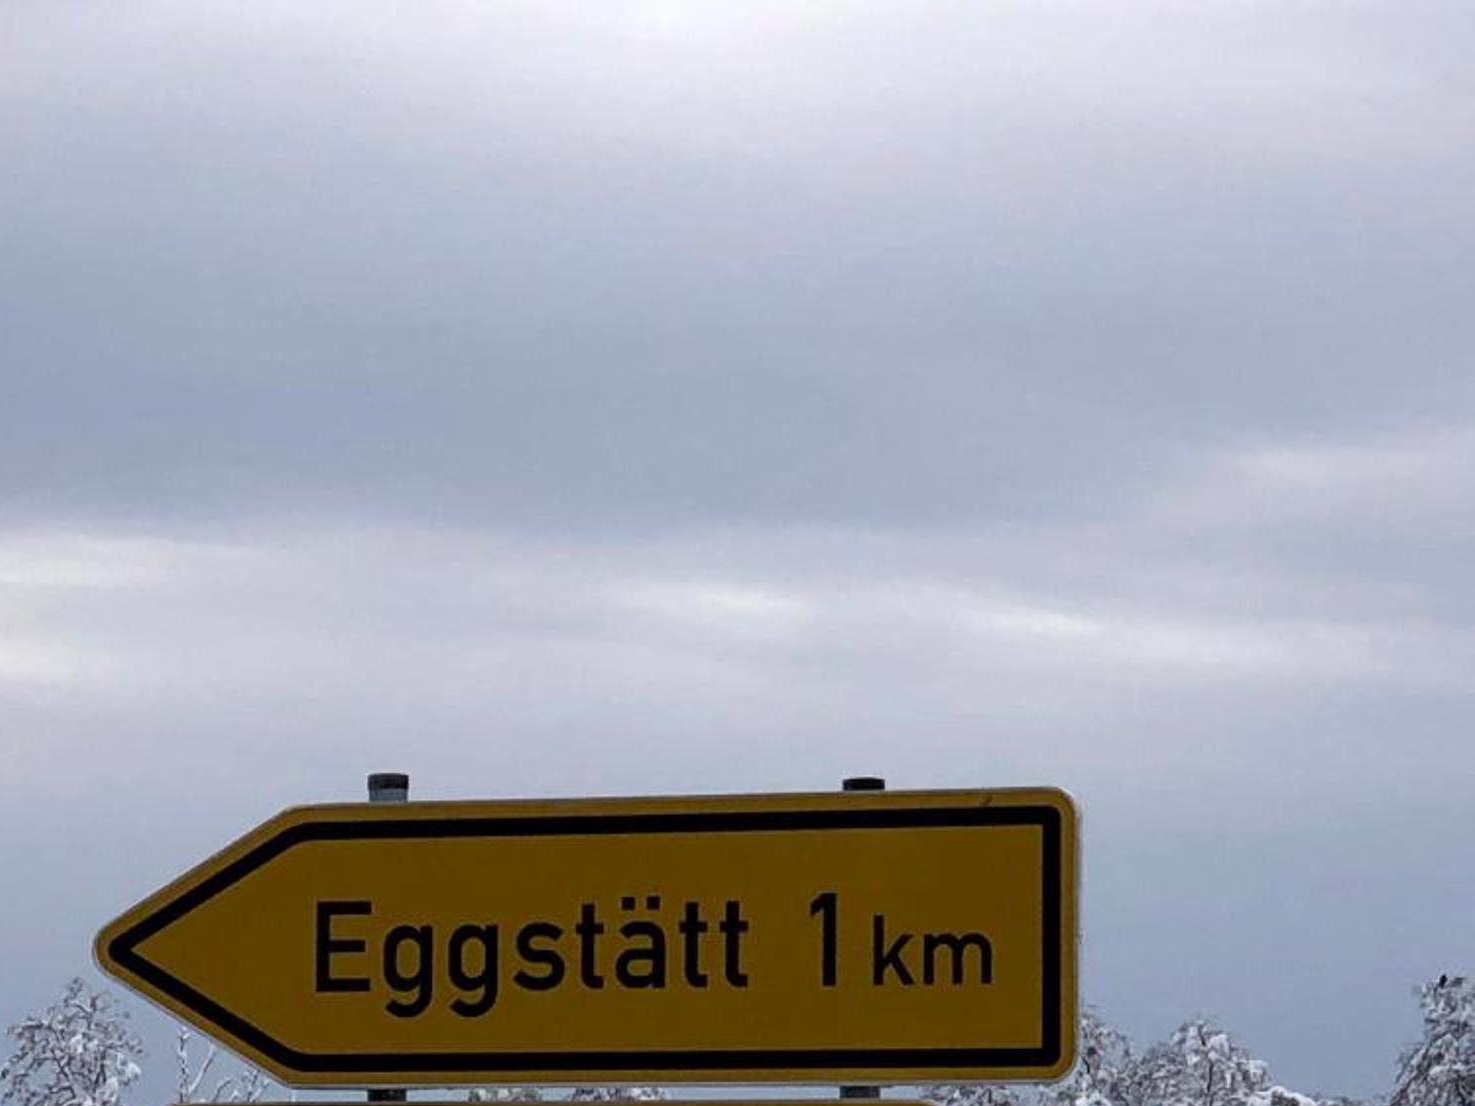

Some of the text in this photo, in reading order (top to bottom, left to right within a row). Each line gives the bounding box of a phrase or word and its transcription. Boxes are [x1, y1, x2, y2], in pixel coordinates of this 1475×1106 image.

[314, 892, 995, 1017] Eggstätt 1 km
